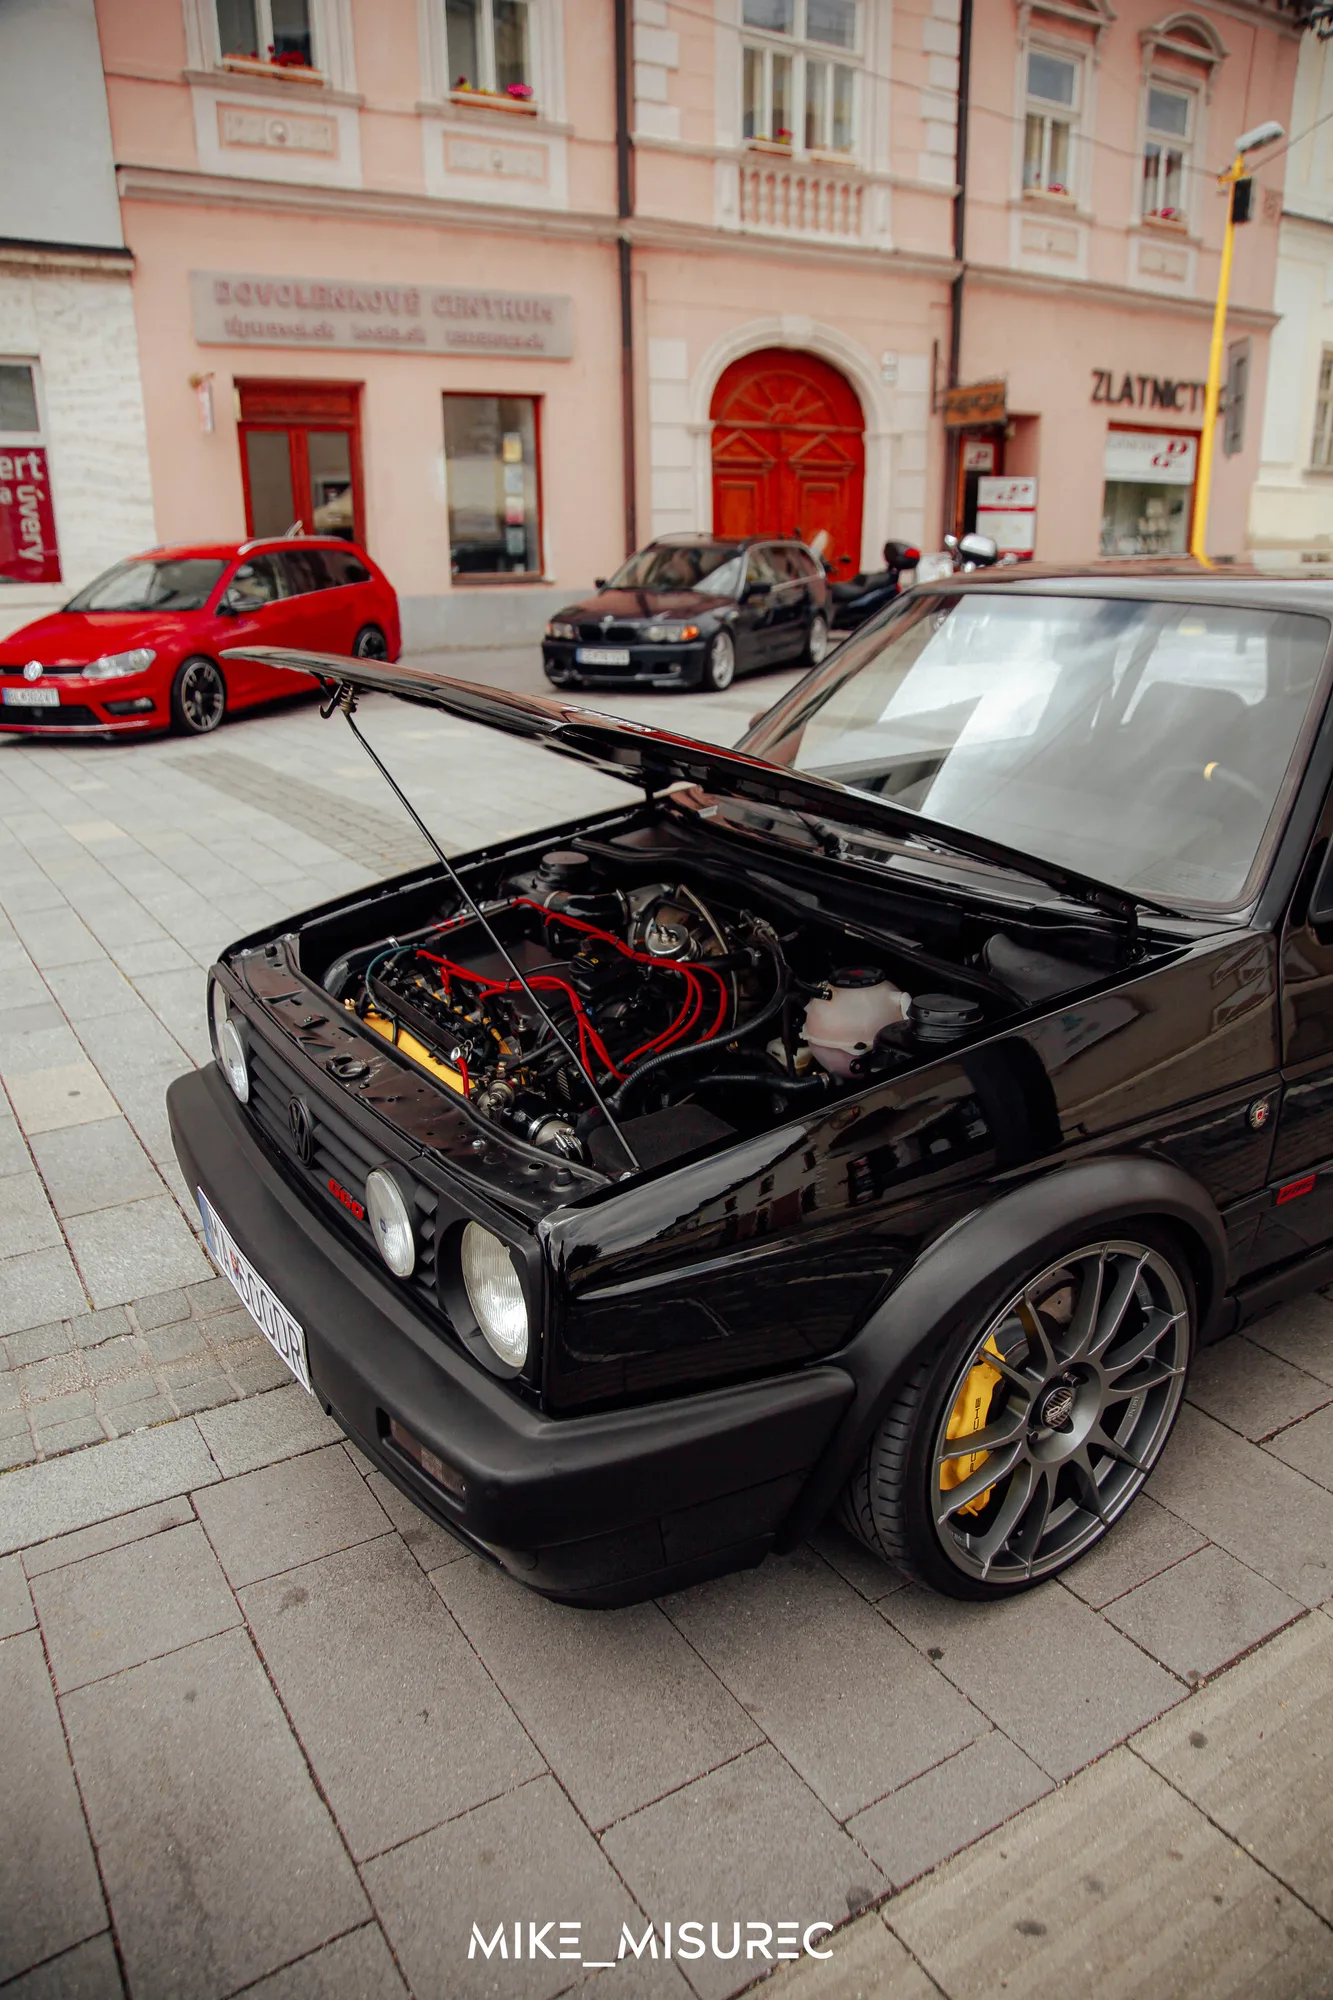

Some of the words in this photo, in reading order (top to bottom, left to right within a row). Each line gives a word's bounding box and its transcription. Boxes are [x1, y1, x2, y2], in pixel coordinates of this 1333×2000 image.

[432, 294, 554, 325] CENTRUM
[17, 484, 45, 562] úvery
[969, 1397, 982, 1473] POCHE
